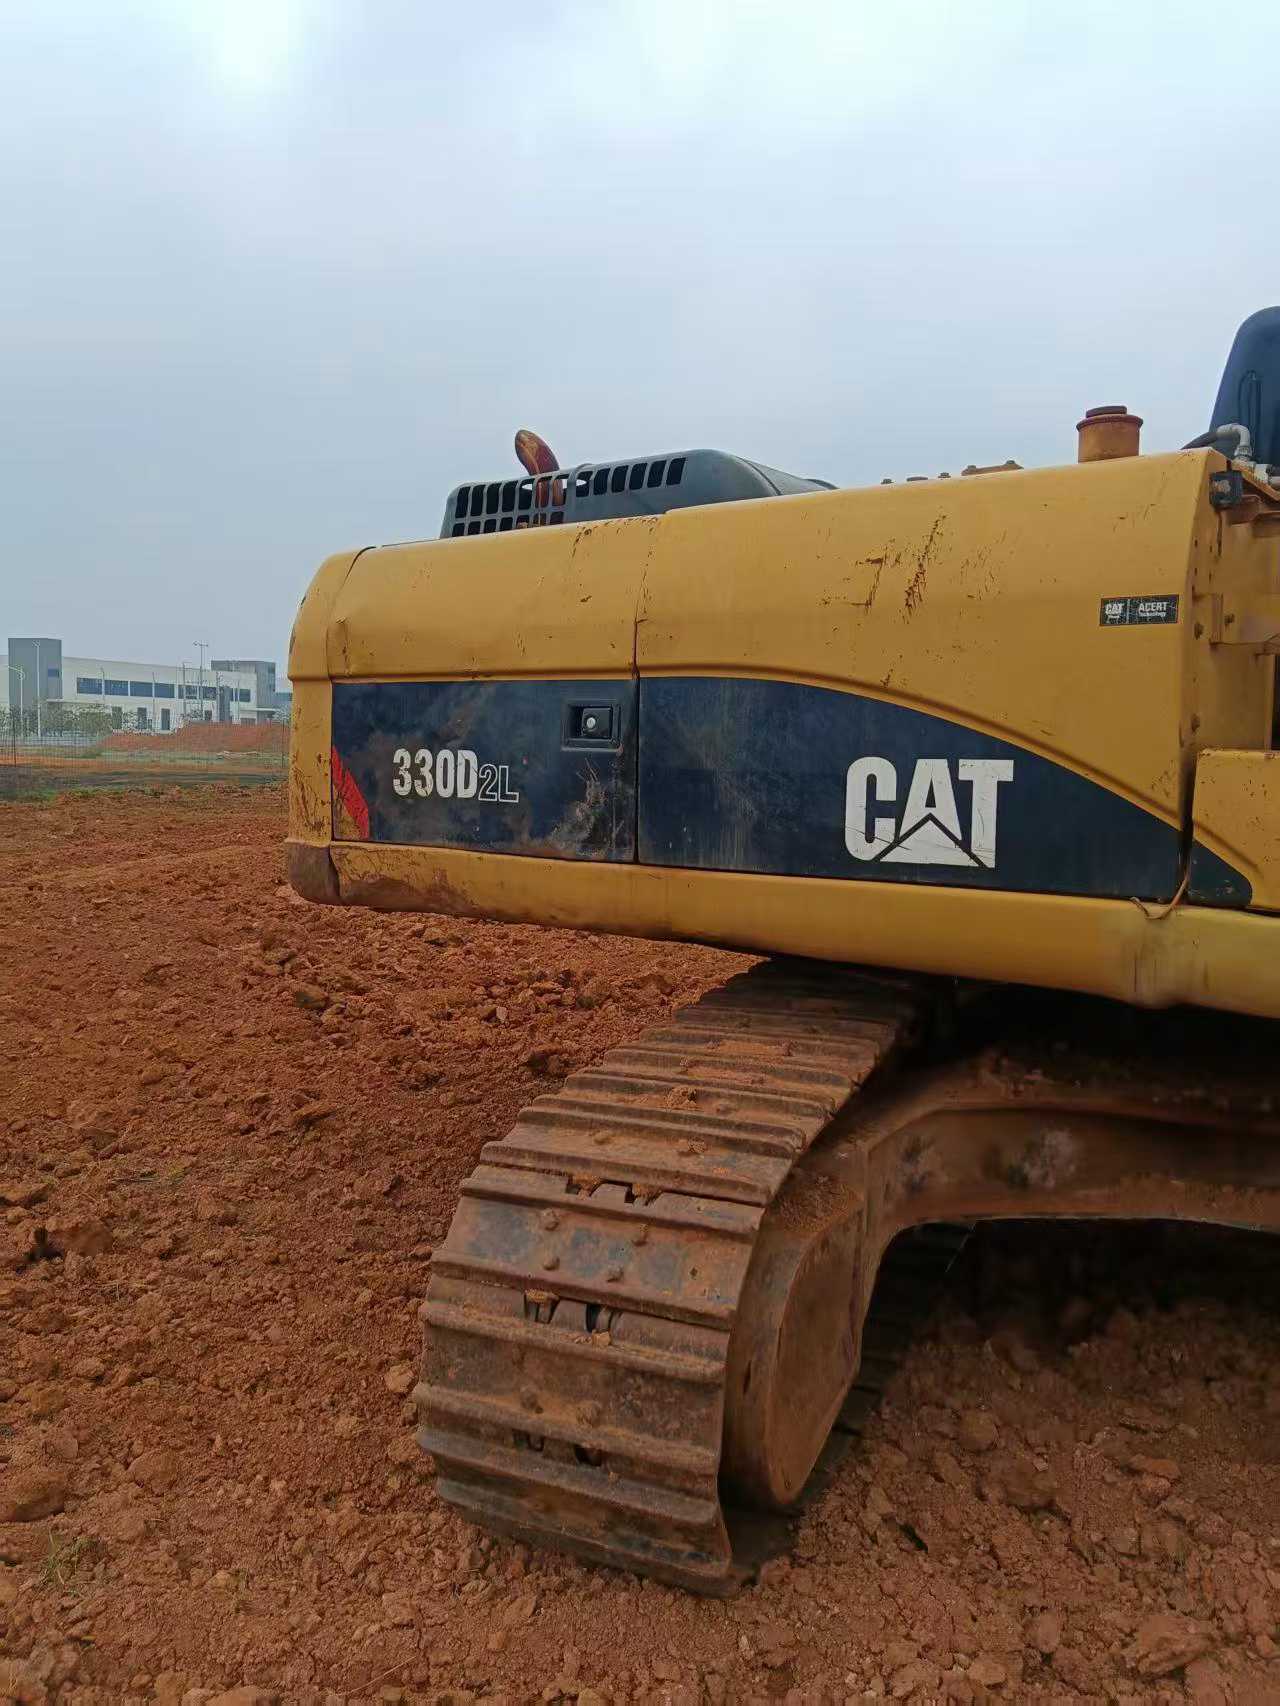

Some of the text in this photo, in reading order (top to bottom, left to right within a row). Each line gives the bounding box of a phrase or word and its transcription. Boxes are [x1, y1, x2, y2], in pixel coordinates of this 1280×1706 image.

[1105, 603, 1124, 614] CAT
[1138, 602, 1168, 612] ACERT
[845, 756, 1014, 869] CAT
